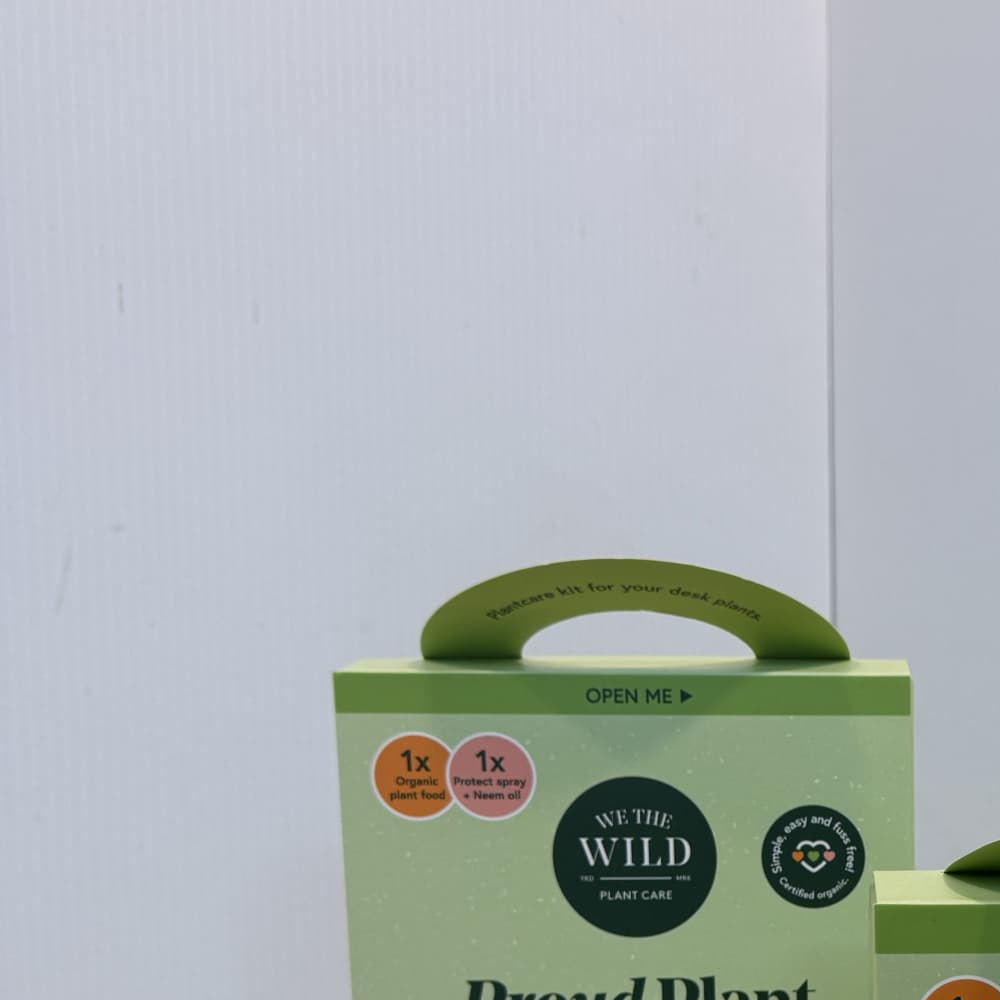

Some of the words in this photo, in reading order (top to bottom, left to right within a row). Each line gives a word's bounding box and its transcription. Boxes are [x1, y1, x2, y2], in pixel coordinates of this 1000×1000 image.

[486, 591, 555, 620] Plantcare
[557, 583, 583, 596] kit
[588, 582, 614, 593] for
[620, 583, 663, 593] your
[669, 587, 711, 601] desk
[585, 687, 639, 704] OPEN
[645, 688, 673, 704] ME
[401, 749, 431, 772] 1x
[475, 749, 506, 772] 1x
[395, 776, 439, 788] Organic
[453, 776, 494, 786] Protect
[496, 778, 526, 789] spray
[390, 790, 418, 802] plant
[421, 790, 446, 800] food
[473, 791, 505, 800] Neem
[507, 790, 521, 800] oil
[595, 808, 629, 829] WE
[632, 808, 673, 830] THE
[579, 837, 691, 867] WILD
[771, 835, 788, 874] Simple,
[784, 816, 808, 834] easy
[810, 815, 833, 827] and
[832, 821, 851, 845] fuss
[844, 845, 858, 873] free!
[600, 890, 638, 901] PLANT
[641, 889, 673, 900] CARE
[779, 876, 815, 900] Certified
